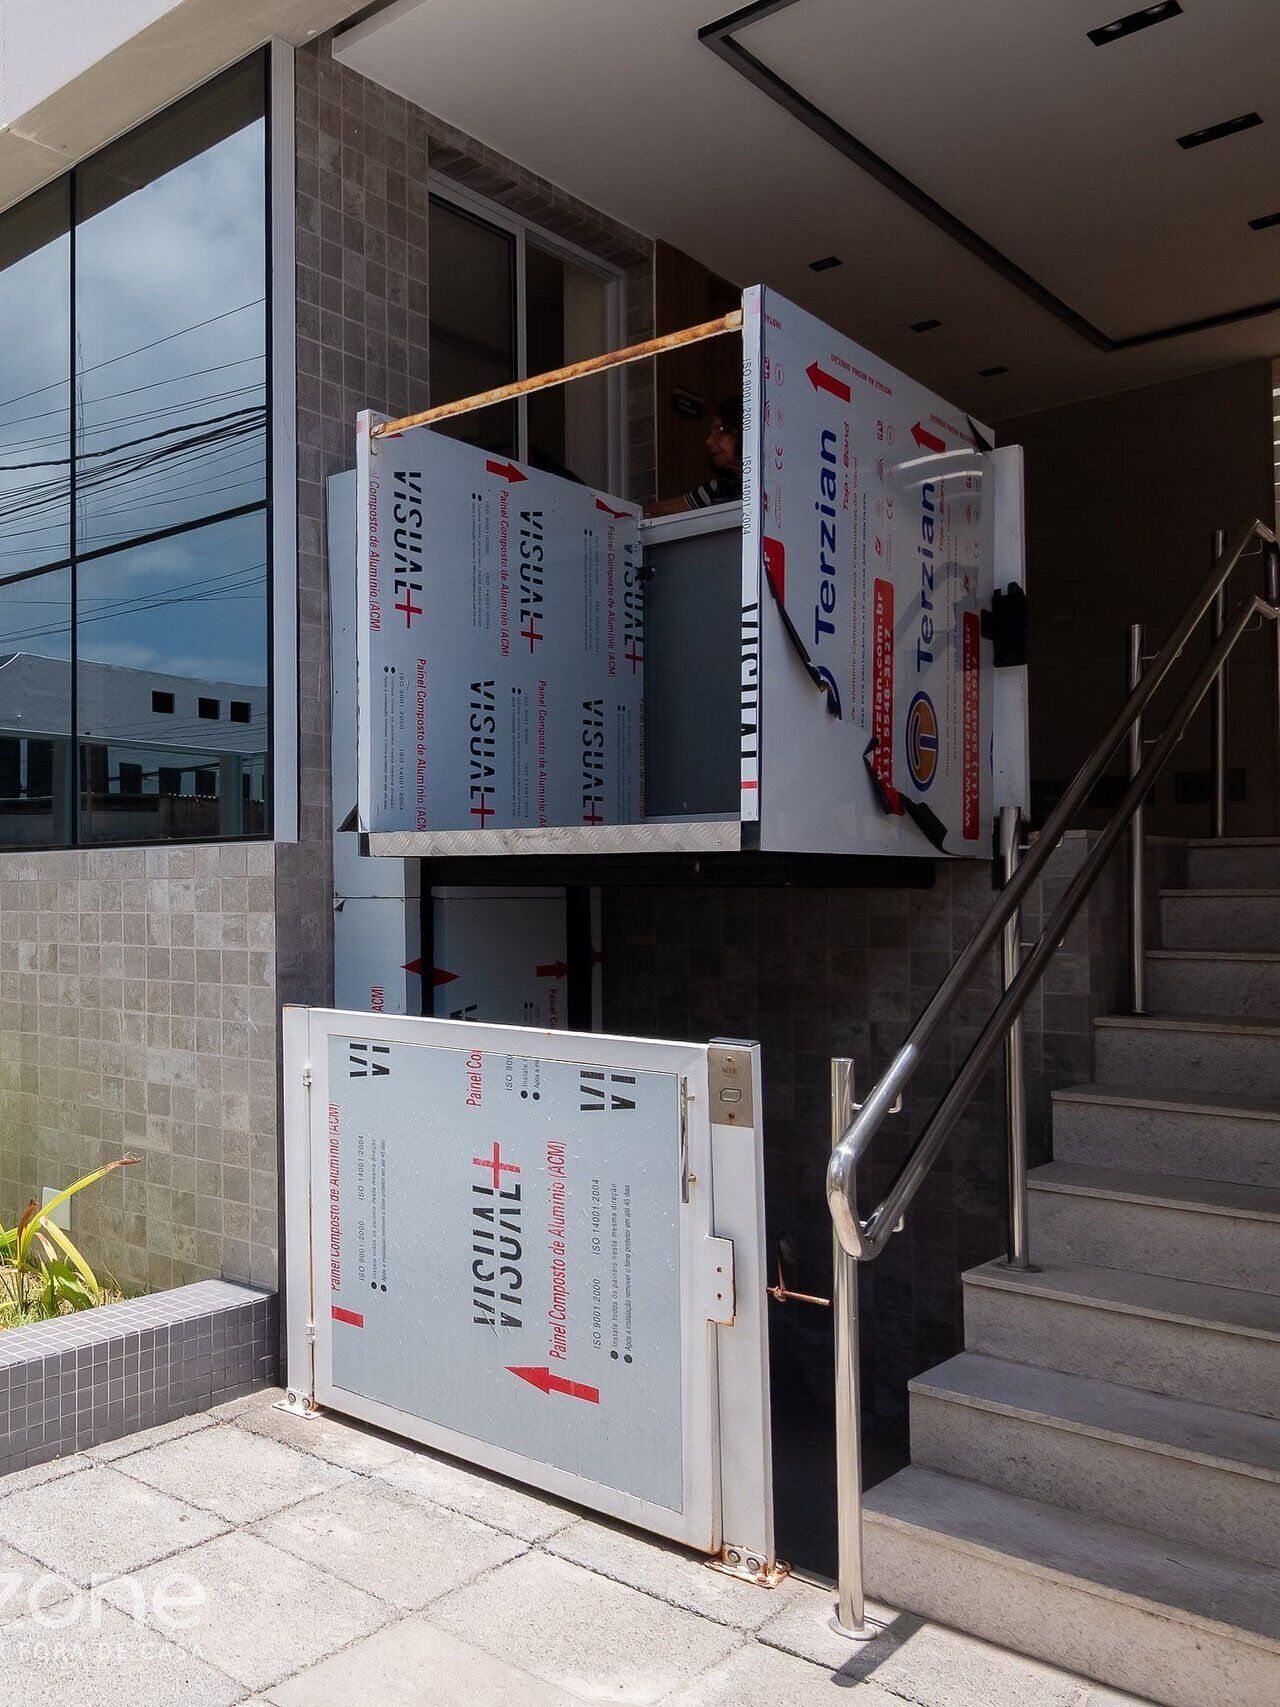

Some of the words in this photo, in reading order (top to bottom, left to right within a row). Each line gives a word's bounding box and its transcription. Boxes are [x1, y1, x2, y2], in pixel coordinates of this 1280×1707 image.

[742, 358, 752, 376] ISO
[742, 381, 752, 432] 9001:2000
[842, 421, 850, 468] Bond
[742, 456, 751, 474] ISO
[368, 481, 379, 533] Composto
[500, 490, 508, 517] Painel
[742, 479, 751, 535] 14001:2004
[842, 482, 850, 512] Top
[369, 536, 379, 547] de
[499, 520, 508, 567] Composto
[607, 526, 615, 551] Painel
[815, 429, 837, 645] Terzian
[369, 551, 380, 597] Alumínio
[500, 570, 509, 581] de
[607, 553, 615, 596] Composto
[917, 480, 935, 673] Terzian
[369, 601, 380, 632] (ACM)
[500, 583, 509, 626] Alumínio
[608, 598, 615, 608] de
[500, 628, 509, 657] (ACM)
[608, 610, 616, 649] Alumínio
[417, 658, 427, 688] Painel
[538, 680, 547, 707] Painel
[416, 691, 427, 740] Composto
[537, 710, 547, 755] Composto
[417, 743, 427, 755] de
[538, 758, 547, 769] de
[417, 758, 427, 804] Alumínio
[539, 771, 547, 811] Alumínio
[466, 1050, 481, 1068] Co
[466, 1072, 481, 1107] Painel
[328, 1103, 341, 1135] (ACM)
[329, 1138, 340, 1186] Alumínio
[547, 1140, 567, 1179] (ACM)
[330, 1189, 340, 1202] de
[547, 1182, 565, 1238] Alumínio
[591, 1179, 600, 1233] 14001:2004
[609, 1183, 619, 1210] direção
[625, 1198, 630, 1206] 45
[330, 1205, 342, 1257] Composto
[625, 1218, 631, 1228] em
[547, 1241, 565, 1256] de
[592, 1237, 600, 1255] ISO
[624, 1229, 632, 1252] protetor
[330, 1260, 341, 1292] Painel
[548, 1259, 569, 1321] Composto
[592, 1279, 601, 1328] 9001:2000
[612, 1291, 618, 1299] os
[625, 1299, 633, 1329] instalação
[549, 1322, 566, 1360] Painel
[593, 1331, 601, 1349] ISO
[611, 1323, 619, 1348] Instale
